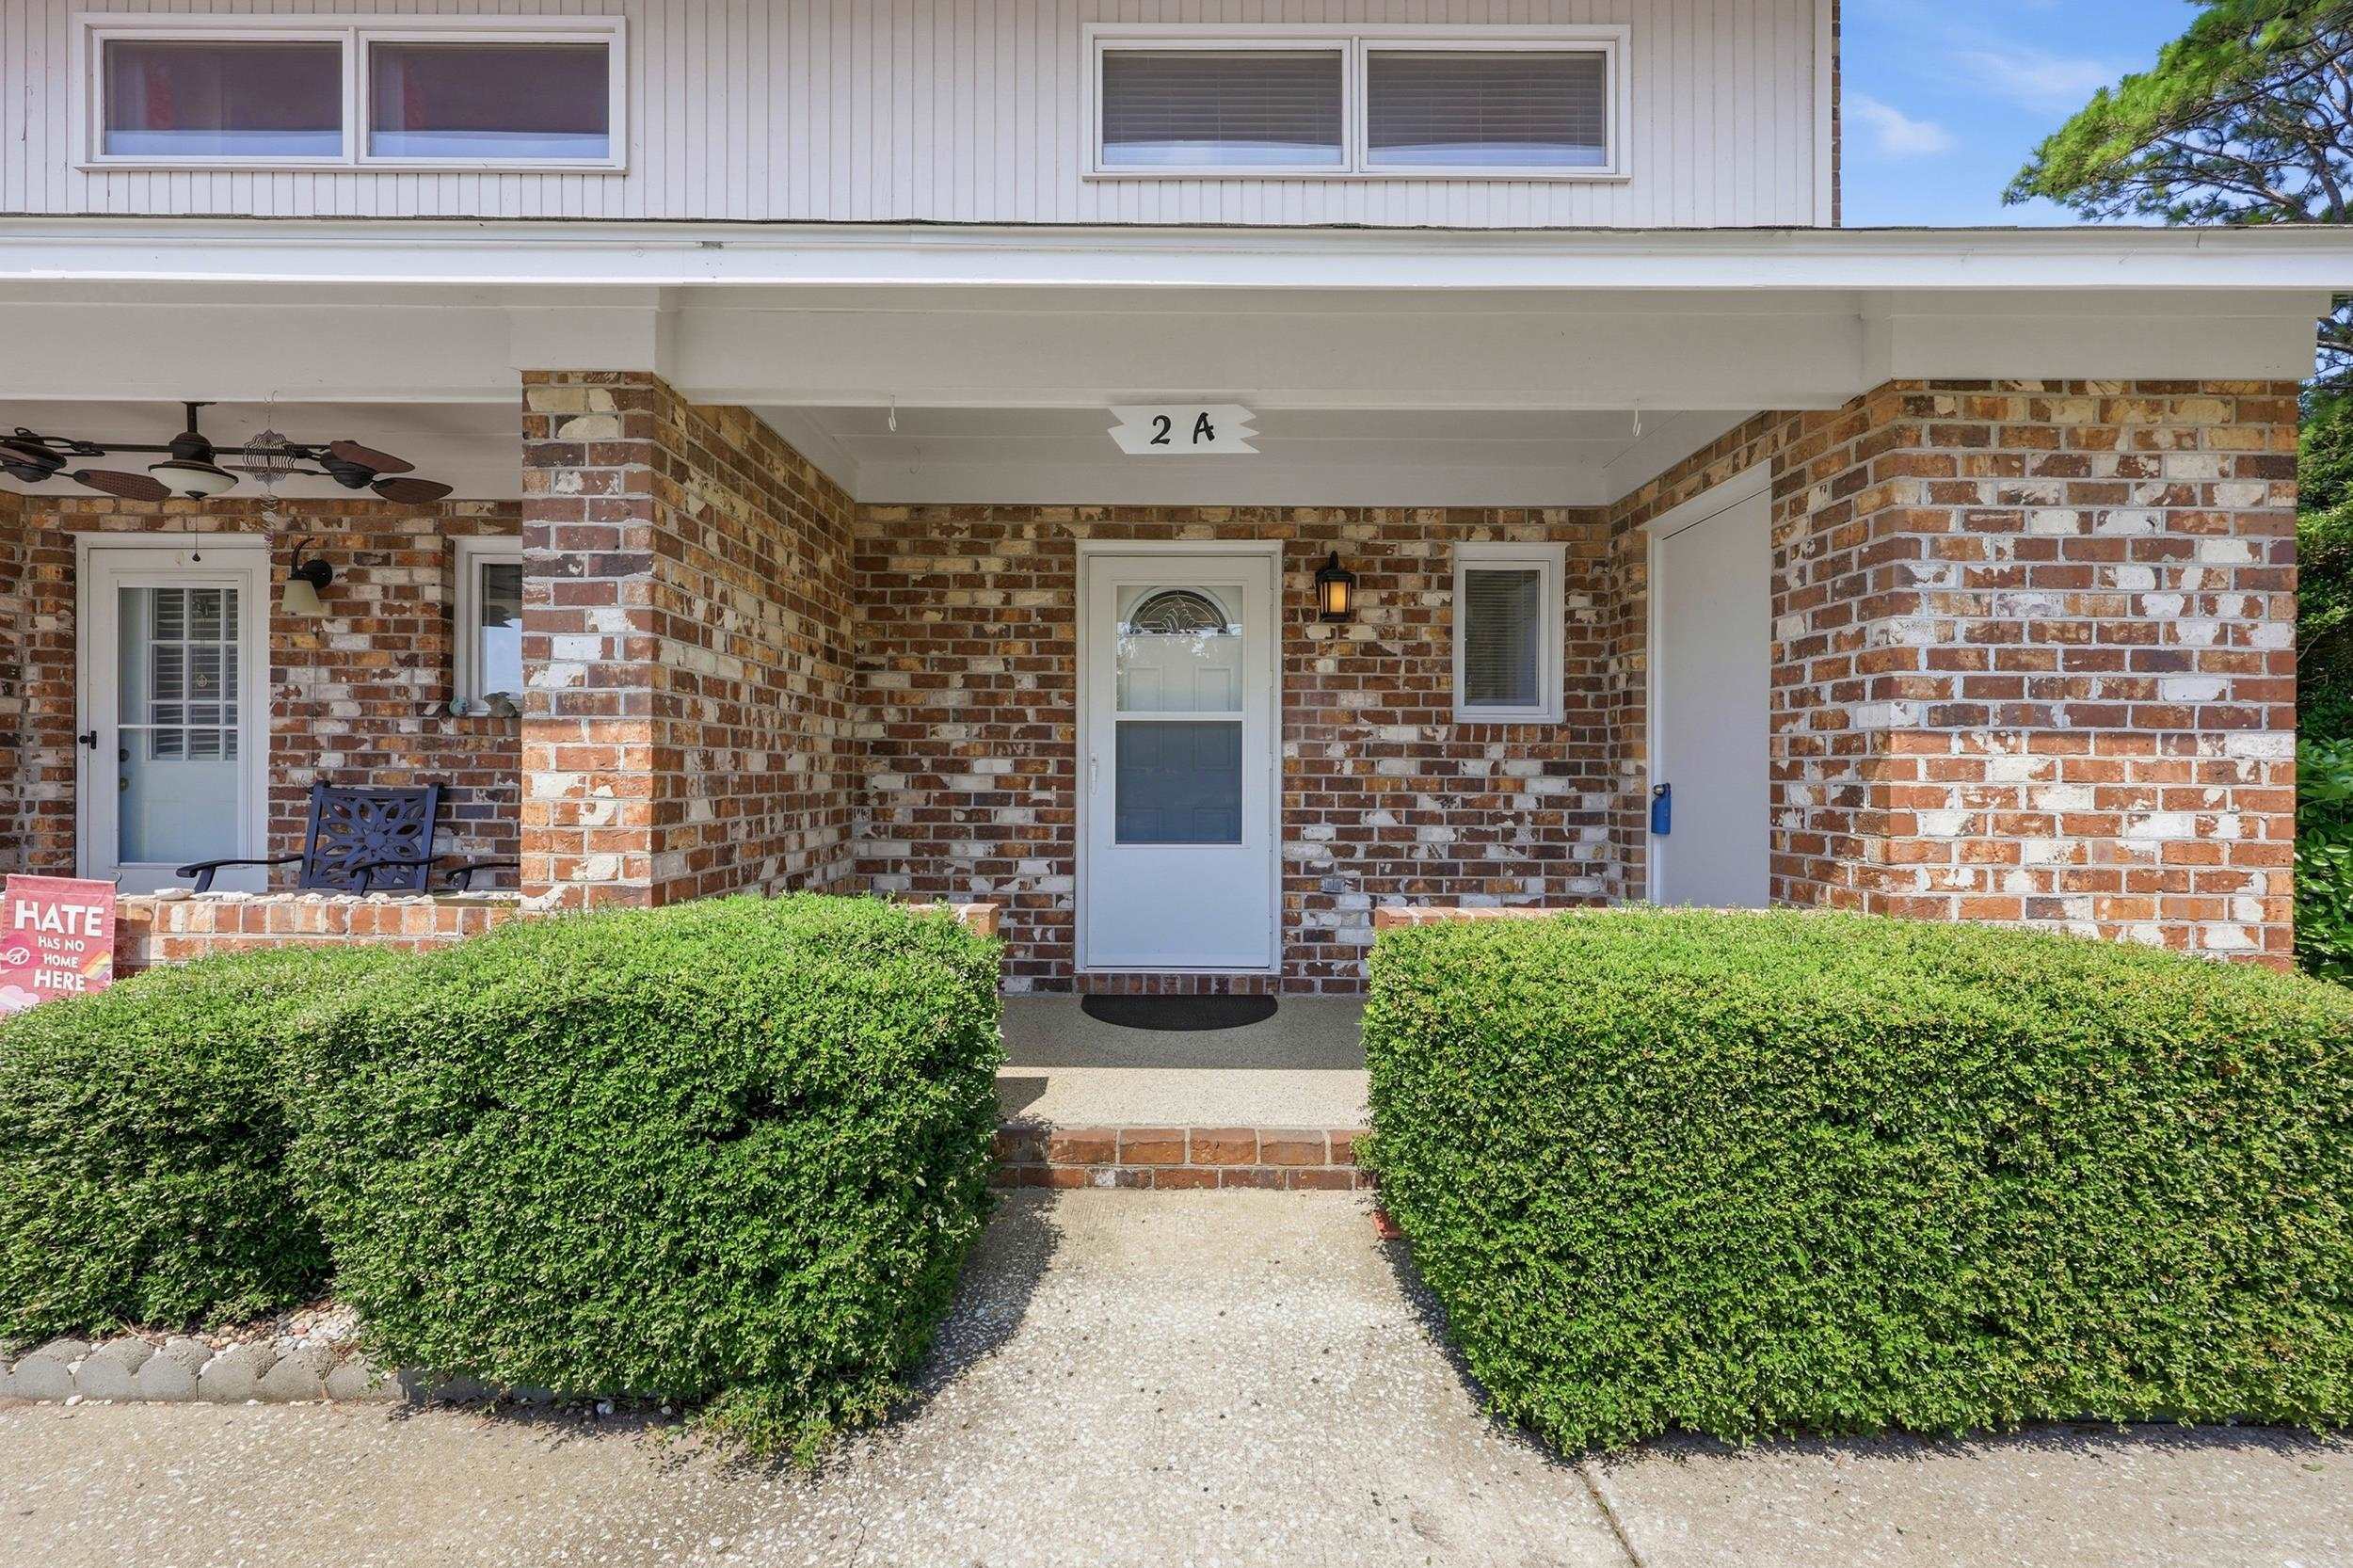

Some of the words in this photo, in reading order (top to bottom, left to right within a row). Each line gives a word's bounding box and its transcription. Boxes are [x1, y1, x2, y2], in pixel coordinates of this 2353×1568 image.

[14, 899, 105, 937] HATE
[38, 935, 61, 951] HAS
[64, 939, 86, 952] NO
[43, 953, 79, 968] HOME
[33, 968, 87, 992] HERE
